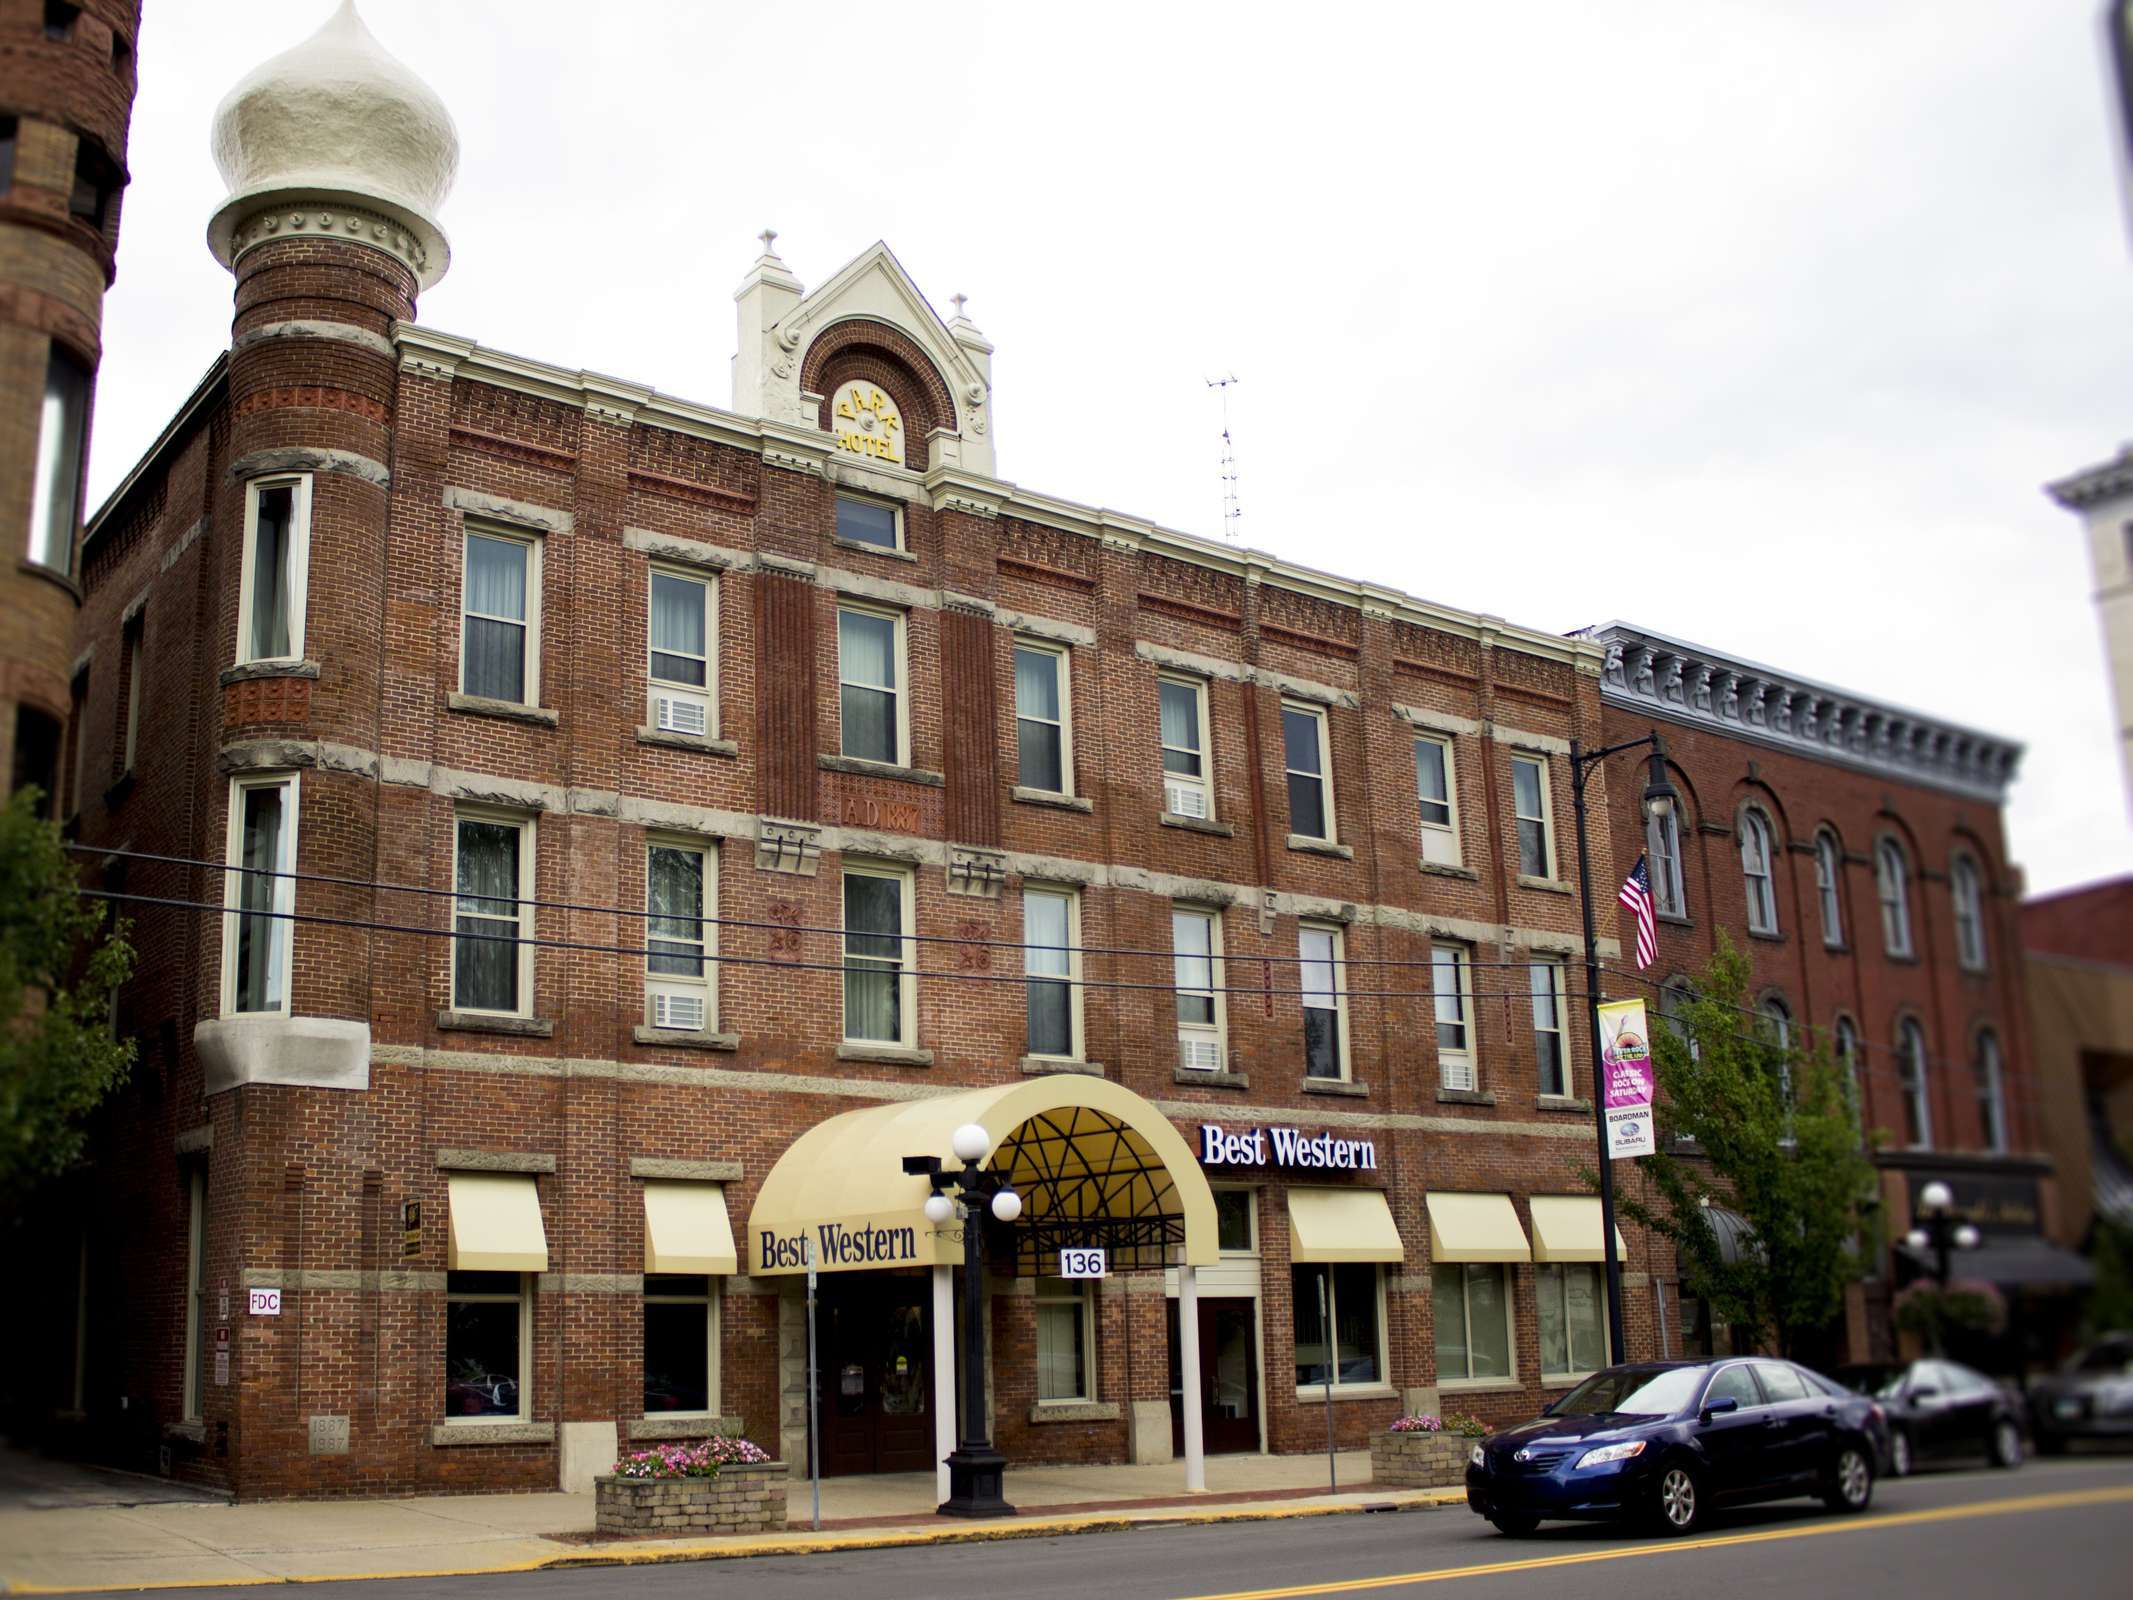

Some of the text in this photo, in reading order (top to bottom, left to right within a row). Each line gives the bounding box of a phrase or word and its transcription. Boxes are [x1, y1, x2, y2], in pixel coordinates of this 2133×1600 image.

[837, 388, 899, 440] PARK
[836, 429, 902, 463] HOTEL
[1609, 1086, 1648, 1098] SATURDAY
[1609, 1111, 1650, 1123] BOARDMAN
[1200, 1125, 1378, 1169] Best Western
[1615, 1136, 1647, 1146] SUBARU
[760, 1221, 917, 1270] Best Western
[1065, 1252, 1102, 1274] 136
[251, 1293, 279, 1311] FDC
